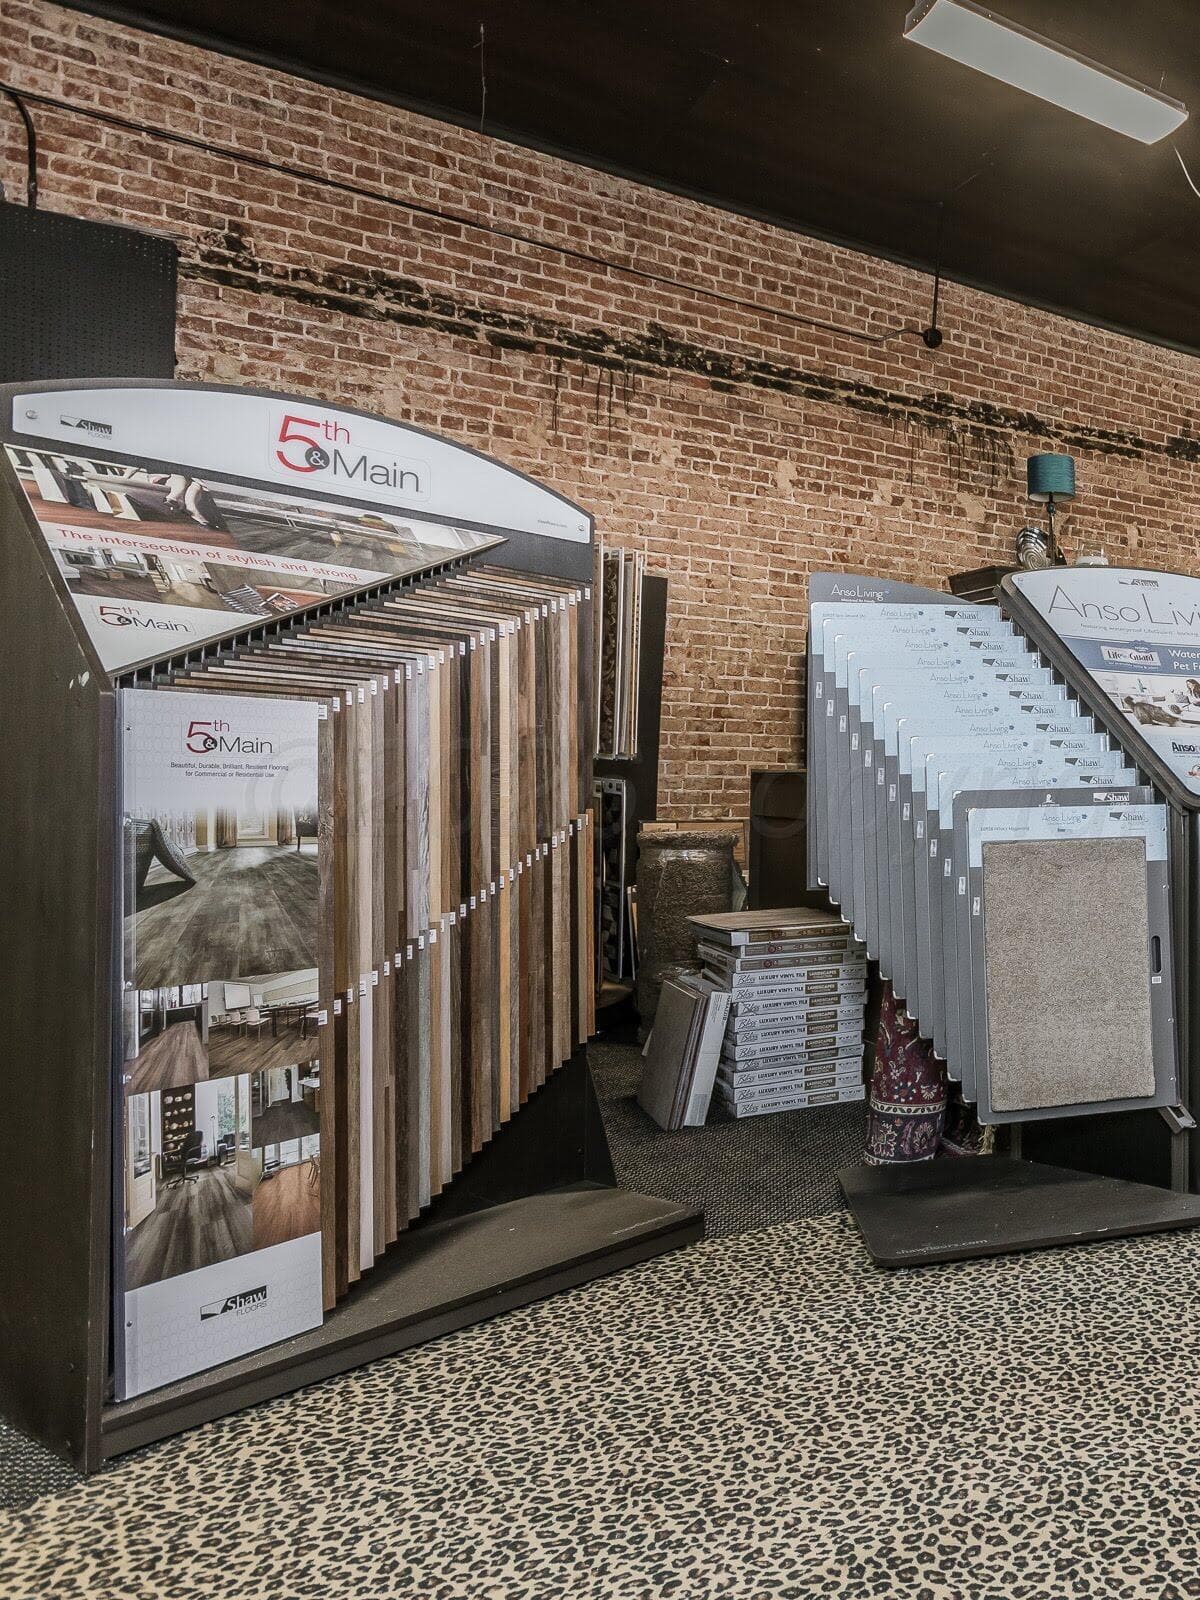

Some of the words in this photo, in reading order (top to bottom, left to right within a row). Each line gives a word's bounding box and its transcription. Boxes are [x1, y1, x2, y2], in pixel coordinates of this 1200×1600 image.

[81, 420, 112, 434] Shaw
[277, 415, 350, 472] 5th
[307, 447, 328, 468] &
[333, 448, 420, 493] Main
[57, 528, 92, 541] The
[99, 534, 201, 556] intersection
[206, 551, 221, 560] of
[226, 553, 276, 568] stylish
[281, 561, 308, 572] and
[312, 567, 361, 582] strong.
[830, 583, 856, 597] Anso
[856, 585, 884, 601] Living
[1048, 584, 1141, 623] Anso
[100, 606, 141, 626] 5th
[132, 617, 191, 632] Main
[957, 611, 979, 620] Shaw
[969, 627, 991, 636] Shaw
[982, 642, 1003, 650] Shaw
[995, 659, 1016, 668] Shaw
[1173, 661, 1190, 671] Pet
[1008, 674, 1030, 683] Shaw
[1022, 690, 1043, 699] Shaw
[1034, 705, 1055, 714] Shaw
[1048, 723, 1070, 732] Shaw
[186, 719, 231, 754] 5th
[202, 736, 218, 750] &
[219, 736, 273, 754] Main
[1062, 740, 1085, 749] Shaw
[1077, 758, 1098, 767] Shaw
[1092, 776, 1113, 784] Shaw
[1106, 792, 1129, 801] Shaw
[1122, 812, 1144, 821] Shaw
[758, 973, 779, 981] LUXURY
[760, 1030, 781, 1038] LUXURY
[759, 1045, 779, 1053] LUXURY
[225, 1288, 267, 1312] Shaw
[236, 1301, 268, 1316] FLOORS
